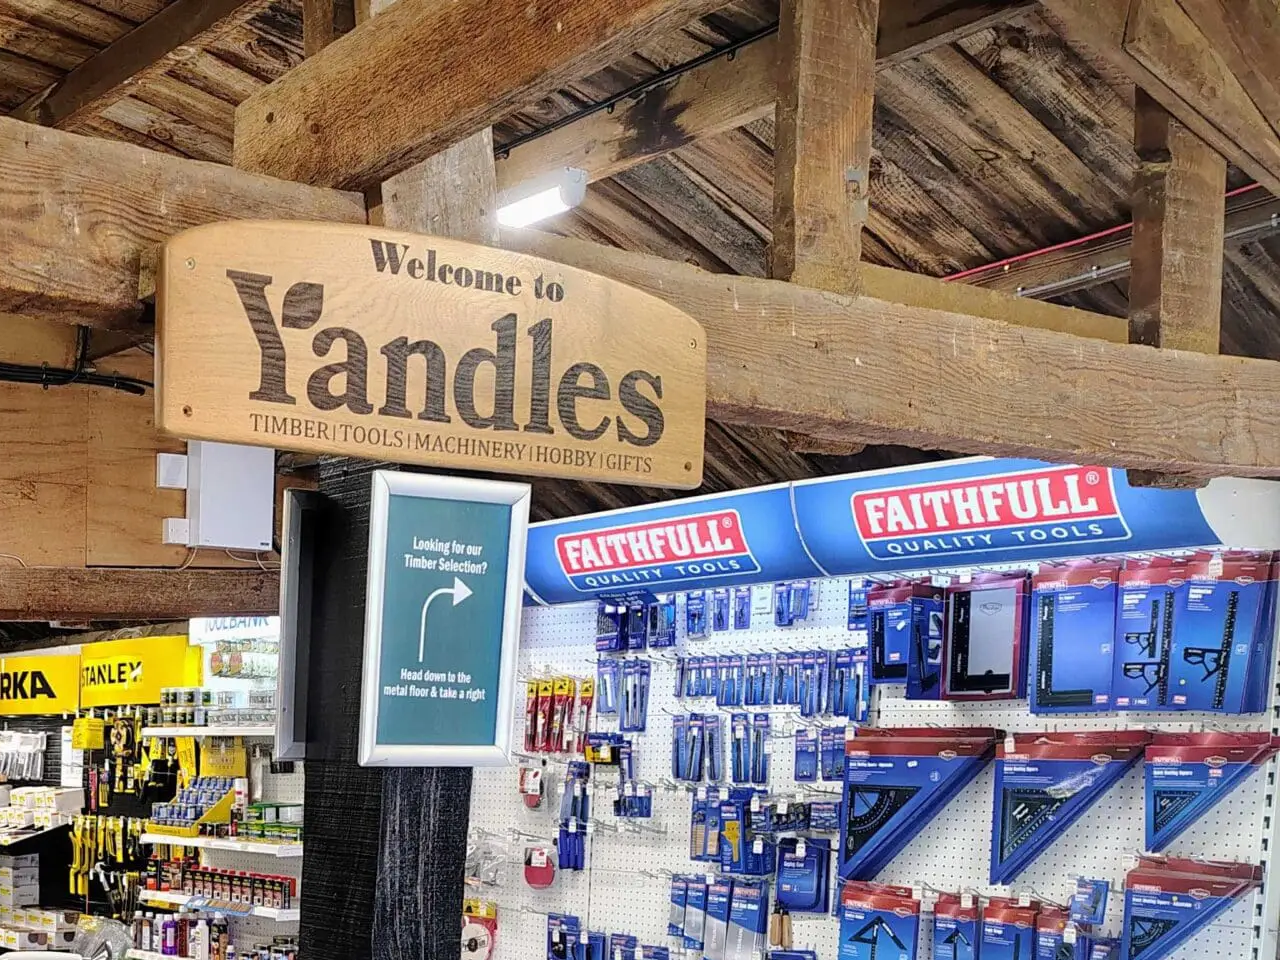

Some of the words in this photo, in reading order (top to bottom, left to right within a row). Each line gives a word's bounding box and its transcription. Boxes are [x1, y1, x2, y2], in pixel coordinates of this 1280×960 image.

[368, 239, 522, 297] Welcome
[534, 276, 564, 302] to
[226, 269, 665, 446] Yandles
[250, 412, 329, 440] TIMBER
[335, 423, 404, 448] TOOLS
[414, 432, 526, 461] MACHINERY
[536, 444, 596, 469] HOBBY
[605, 453, 652, 474] GIFTS
[863, 473, 1098, 534] FAITHFULL
[413, 536, 450, 556] Looking
[451, 541, 466, 555] for
[466, 545, 482, 556] our
[564, 518, 734, 570] FAITHFULL
[887, 534, 993, 555] QUALITY
[1012, 523, 1104, 542] TOOLS
[404, 554, 437, 571] Timber
[438, 556, 488, 575] Selection?
[585, 568, 664, 587] QUALITY
[674, 559, 741, 575] TOOLS
[82, 661, 142, 687] STANLEY
[400, 668, 422, 681] Head
[424, 669, 447, 682] down
[448, 671, 456, 682] to
[457, 672, 471, 684] the
[384, 685, 407, 697] metal
[409, 685, 429, 698] floor
[430, 687, 438, 698] &
[439, 687, 457, 699] take
[459, 690, 465, 699] a
[466, 688, 485, 702] right
